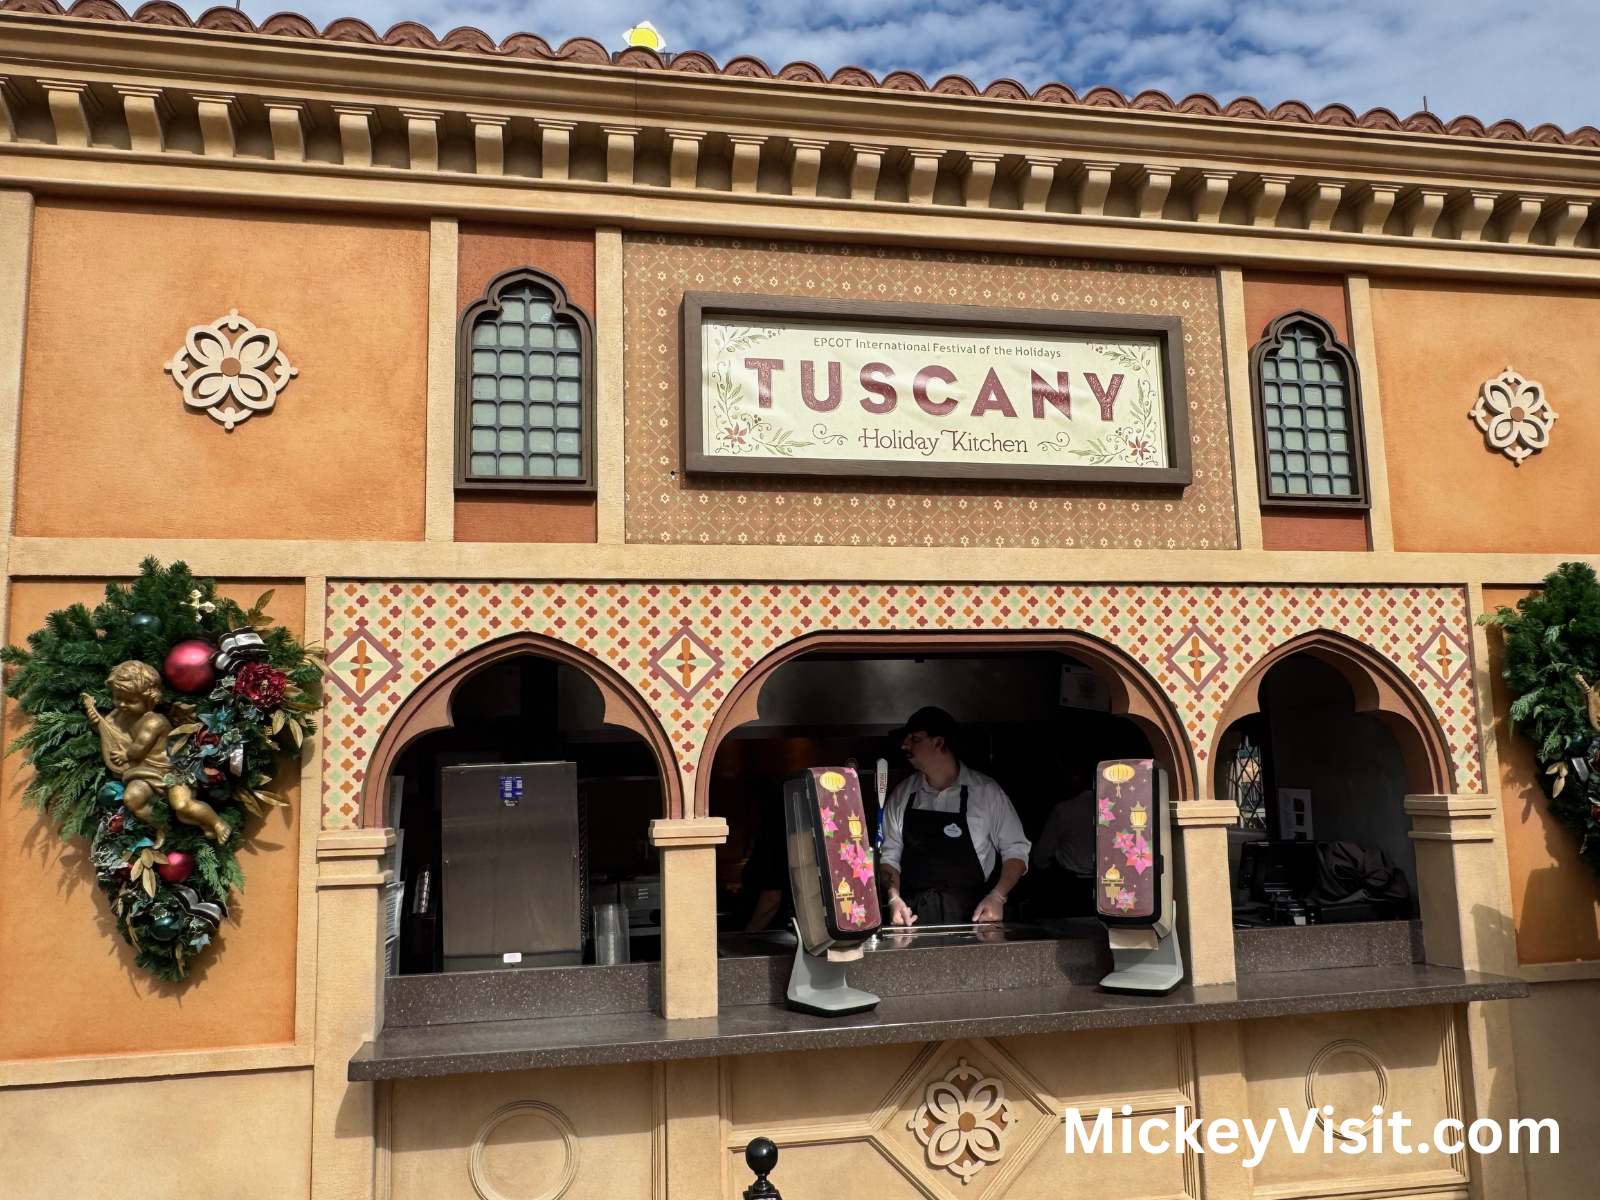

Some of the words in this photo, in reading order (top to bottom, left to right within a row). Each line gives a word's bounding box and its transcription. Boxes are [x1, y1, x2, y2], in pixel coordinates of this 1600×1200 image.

[813, 337, 852, 348] EPCOT
[856, 338, 931, 352] International
[933, 342, 977, 354] Festival
[979, 345, 991, 355] of
[994, 345, 1013, 356] the
[1015, 346, 1062, 360] Holidays
[744, 357, 1126, 422] TUSCANY
[858, 427, 940, 457] Holiday
[940, 429, 1029, 453] Kitchen
